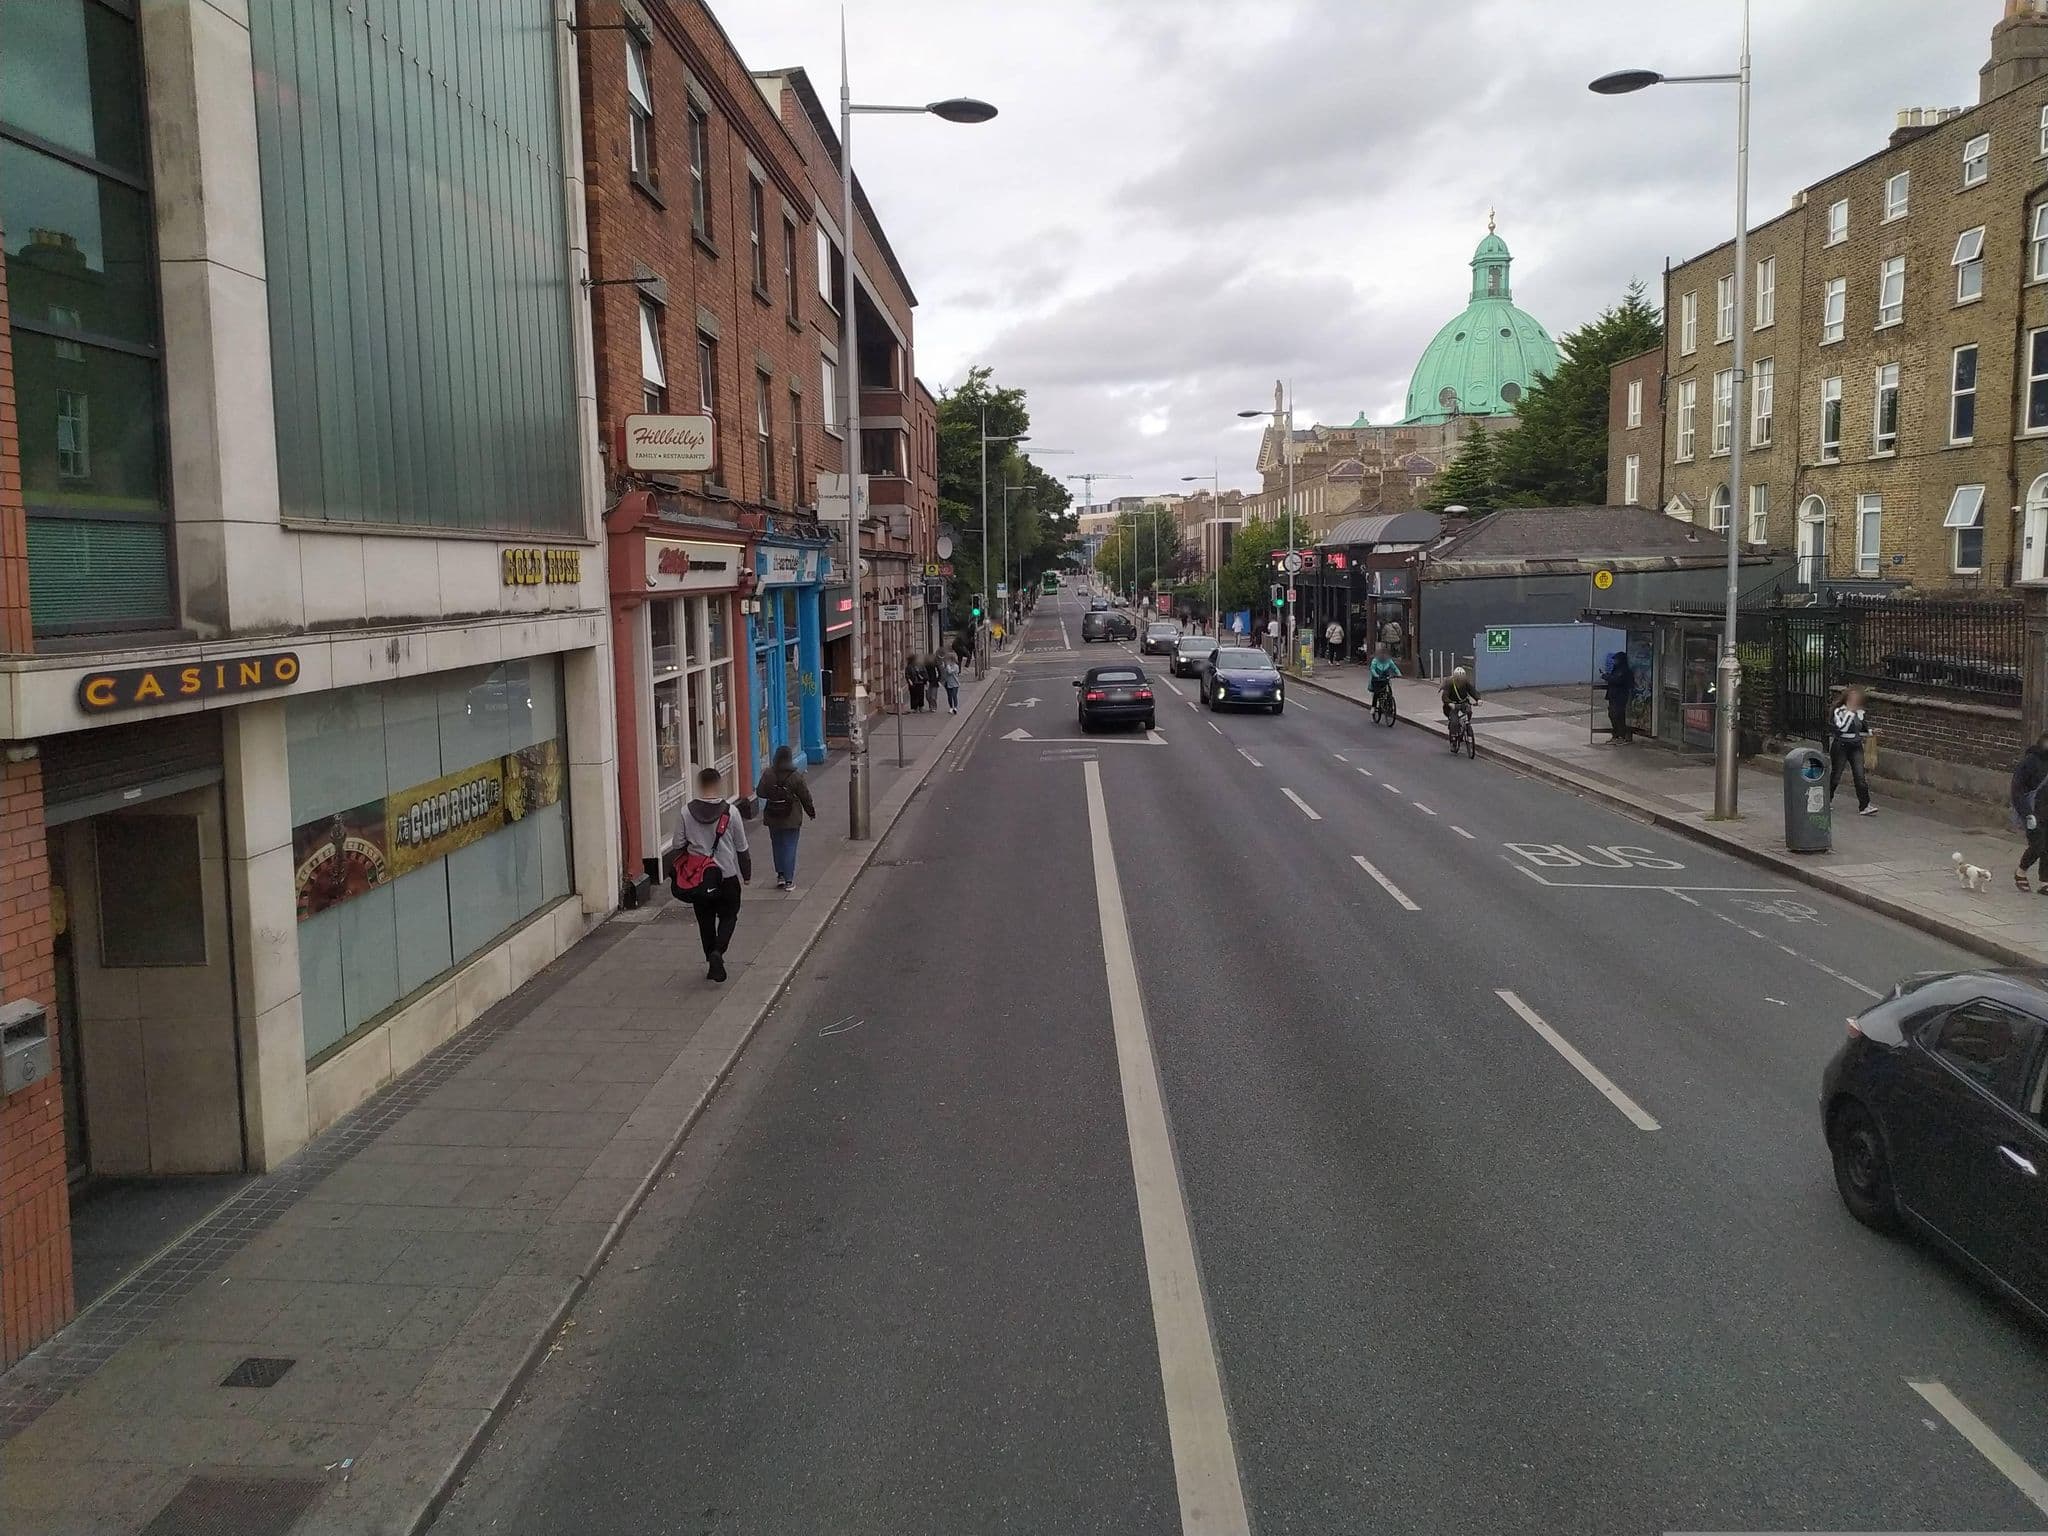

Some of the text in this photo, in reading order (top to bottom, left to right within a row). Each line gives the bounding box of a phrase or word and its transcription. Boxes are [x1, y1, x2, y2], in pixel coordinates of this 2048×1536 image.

[633, 427, 705, 450] Hillbilly's
[504, 549, 581, 584] GOLD RUSH
[86, 657, 298, 706] CASINO
[410, 792, 449, 845] GOLD
[449, 777, 490, 828] RUSH
[1502, 842, 1687, 870] BUS
